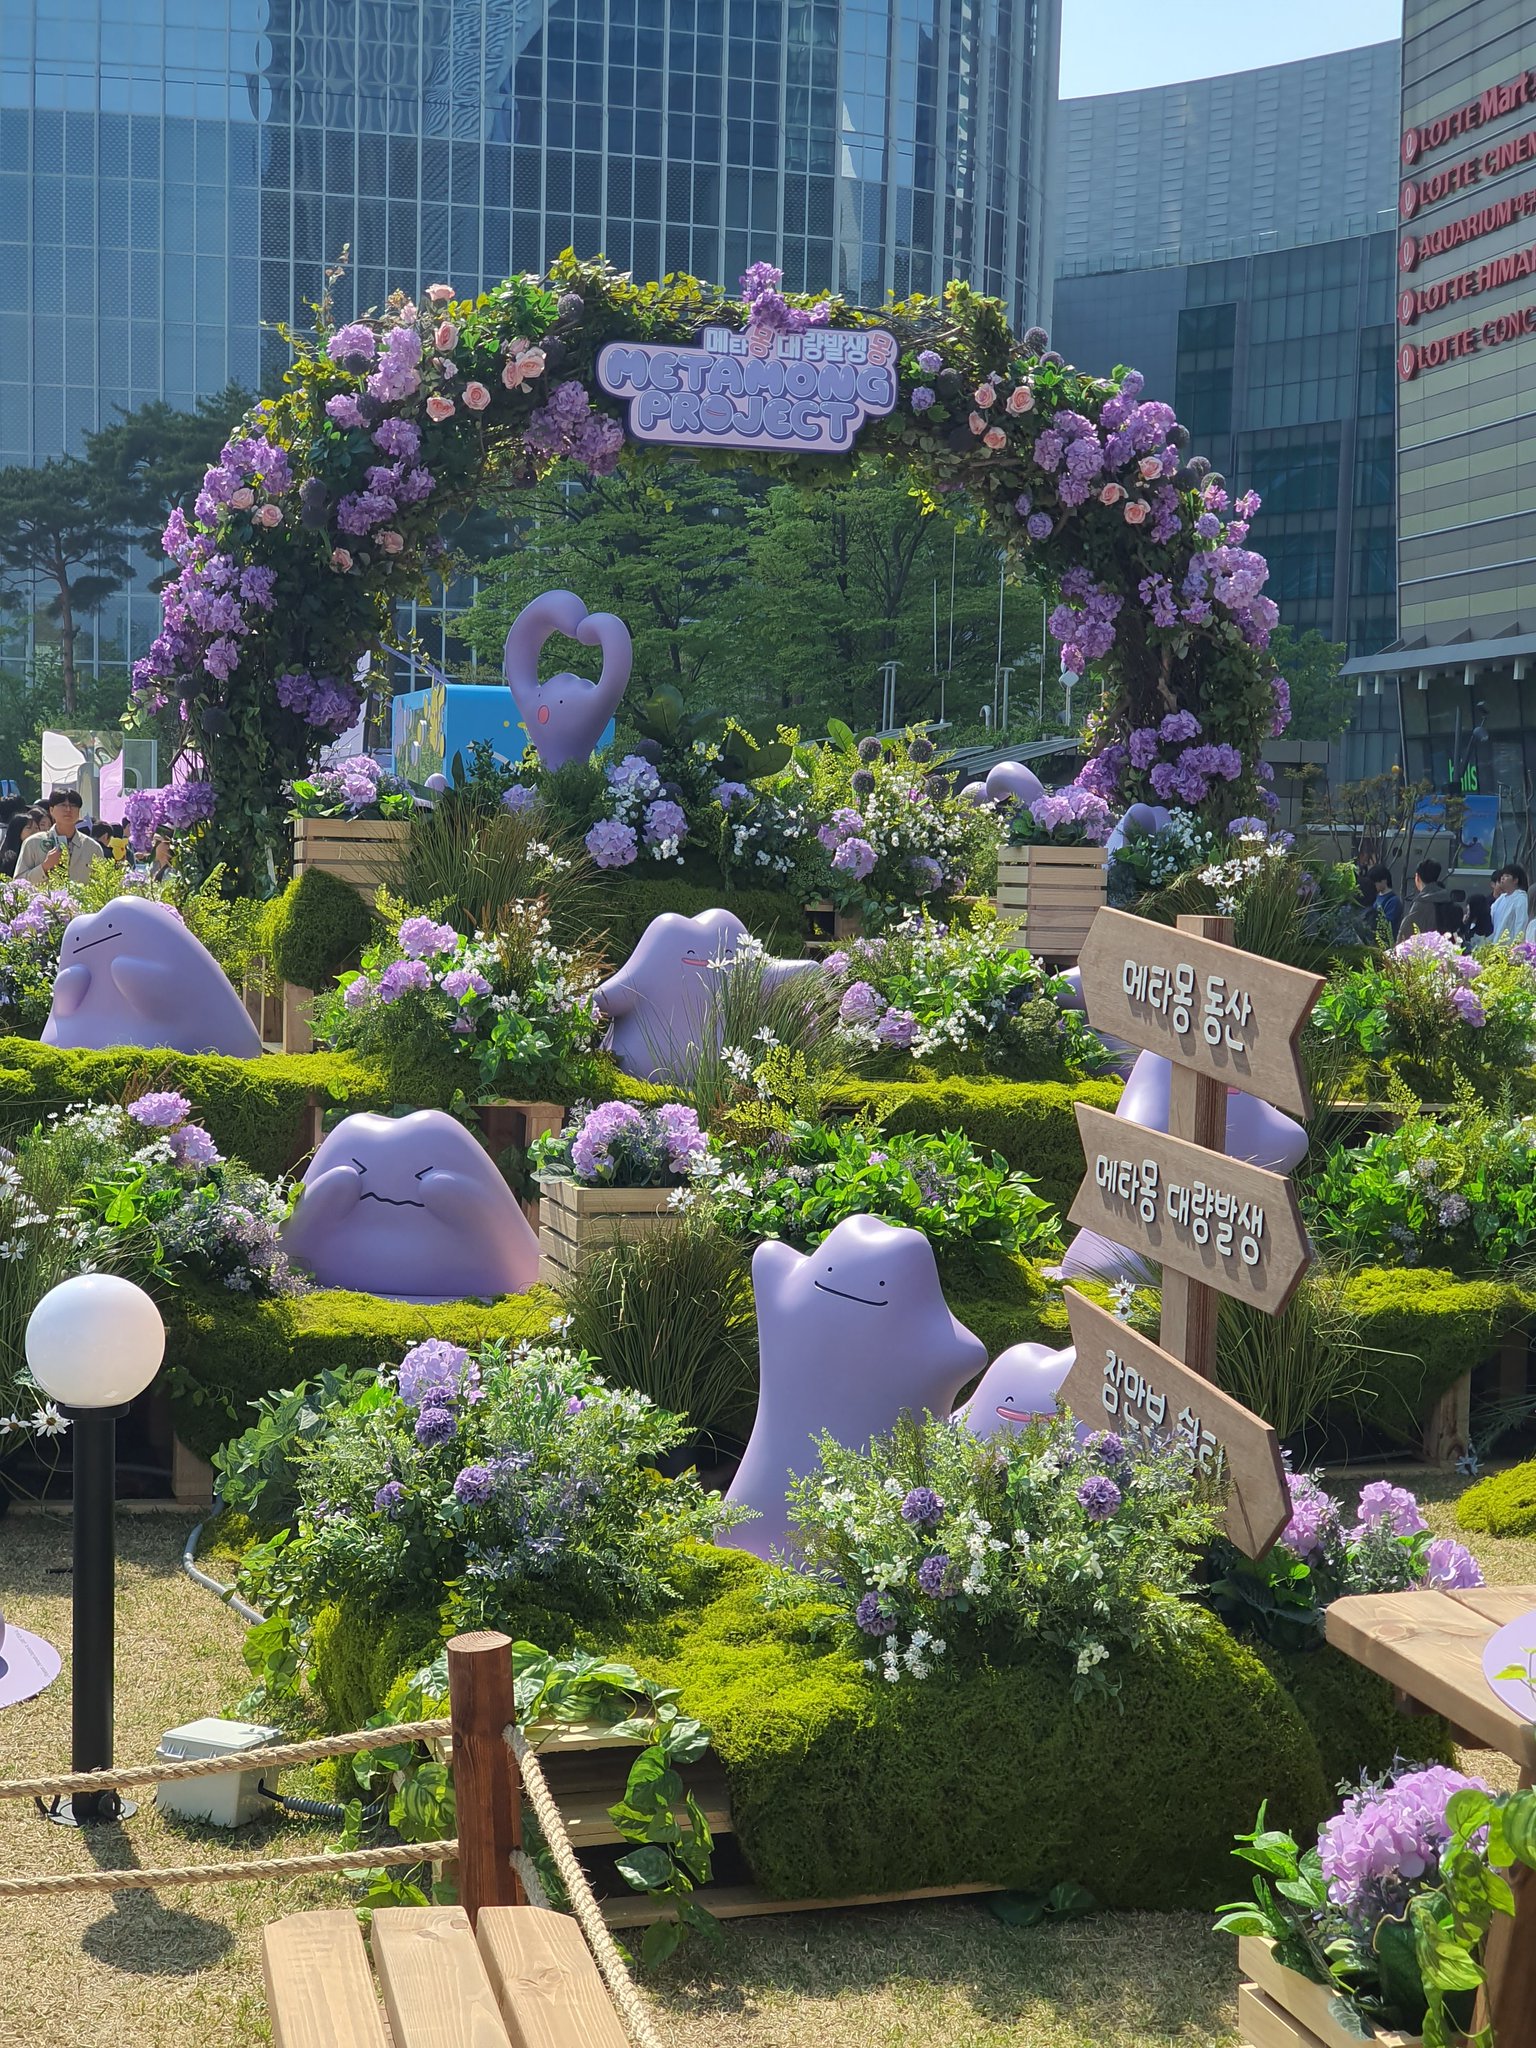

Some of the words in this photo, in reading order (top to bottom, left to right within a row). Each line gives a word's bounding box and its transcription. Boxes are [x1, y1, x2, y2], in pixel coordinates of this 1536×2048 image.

[1420, 102, 1479, 152] LOTTE
[1479, 70, 1528, 125] Mart
[1420, 157, 1476, 205] LOTTE
[1418, 198, 1513, 260] AQUARIUM
[1416, 271, 1473, 315] LOTTE
[704, 322, 774, 359] 메타몽
[1417, 328, 1474, 369] LOTTE
[604, 347, 895, 405] METAMONG
[637, 389, 857, 441] PROJECT
[1122, 959, 1194, 1034] 메타몽
[1203, 975, 1252, 1052] 동산
[1095, 1154, 1159, 1223] 메타몽
[1166, 1180, 1265, 1266] 대량발생
